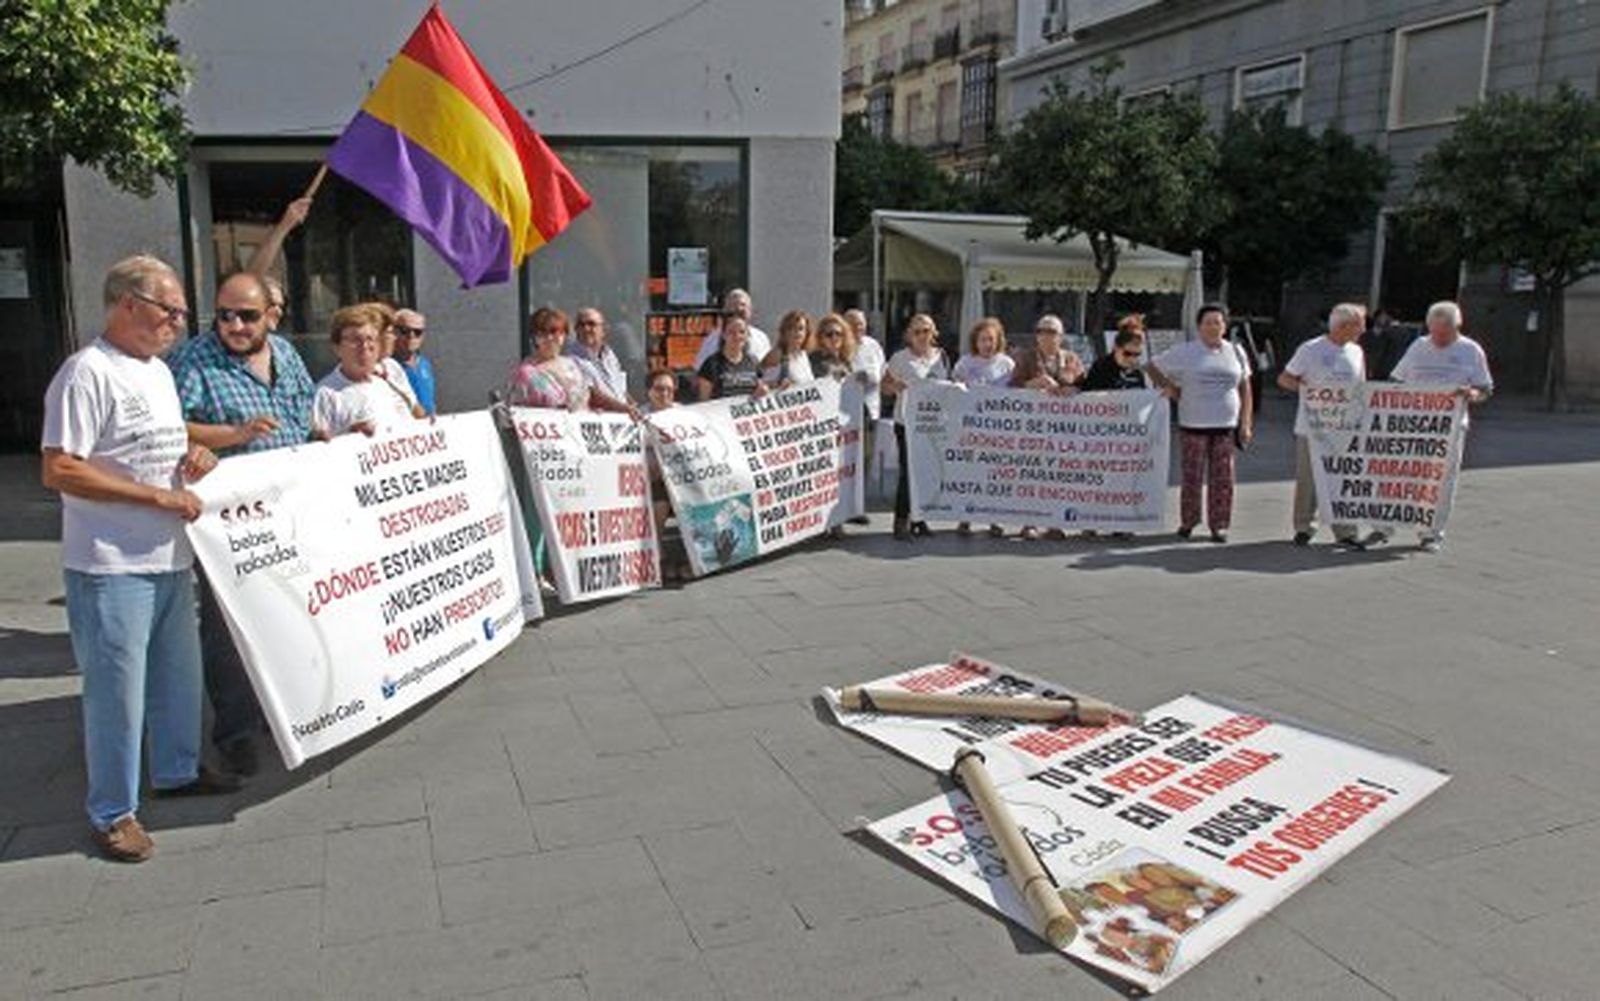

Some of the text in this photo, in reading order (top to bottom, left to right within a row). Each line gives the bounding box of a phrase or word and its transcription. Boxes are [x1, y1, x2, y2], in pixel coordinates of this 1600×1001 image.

[759, 397, 775, 413] LA
[736, 420, 753, 437] NO
[753, 416, 770, 433] ES
[770, 413, 785, 429] TU
[962, 415, 1022, 432] MUCHOS
[1026, 418, 1043, 434] SE
[1047, 421, 1077, 434] HAN
[1370, 414, 1452, 435] A BUSCAR
[758, 434, 772, 450] LO
[1059, 441, 1076, 453] LA
[1347, 436, 1448, 458] A NUESTROS
[747, 456, 762, 472] EL
[800, 443, 815, 457] DE
[945, 449, 974, 462] QUE
[978, 450, 1042, 468] ARCHIVA
[1046, 456, 1056, 467] Y
[1059, 458, 1081, 469] NO
[1366, 457, 1445, 480] ROBADOS
[354, 460, 468, 507] MILES DE MADRES
[753, 473, 770, 489] ES
[770, 465, 793, 484] MUY
[1020, 467, 1104, 486] PARAREMOS
[757, 490, 774, 507] NO
[940, 480, 982, 495] HASTA
[986, 482, 1013, 497] QUE
[1017, 483, 1036, 498] OS
[1340, 479, 1439, 505] POR MAFIAS
[379, 492, 470, 538] DESTROZADAS
[759, 504, 788, 523] PARA
[431, 520, 487, 560] NUESTROS
[761, 525, 784, 545] UNA
[463, 548, 496, 581] CASOS
[384, 627, 411, 656] NO
[410, 610, 444, 645] HAN
[1027, 766, 1078, 789] TU
[1062, 733, 1158, 776] PUEDES
[1140, 716, 1197, 740] SER
[1070, 783, 1125, 809] LA
[1102, 756, 1186, 794] PIEZA
[1163, 736, 1224, 764] QUE
[1115, 801, 1173, 831] EN
[1149, 785, 1203, 812] MI
[1188, 796, 1288, 848] BUSCA
[1227, 840, 1304, 880] TUS
